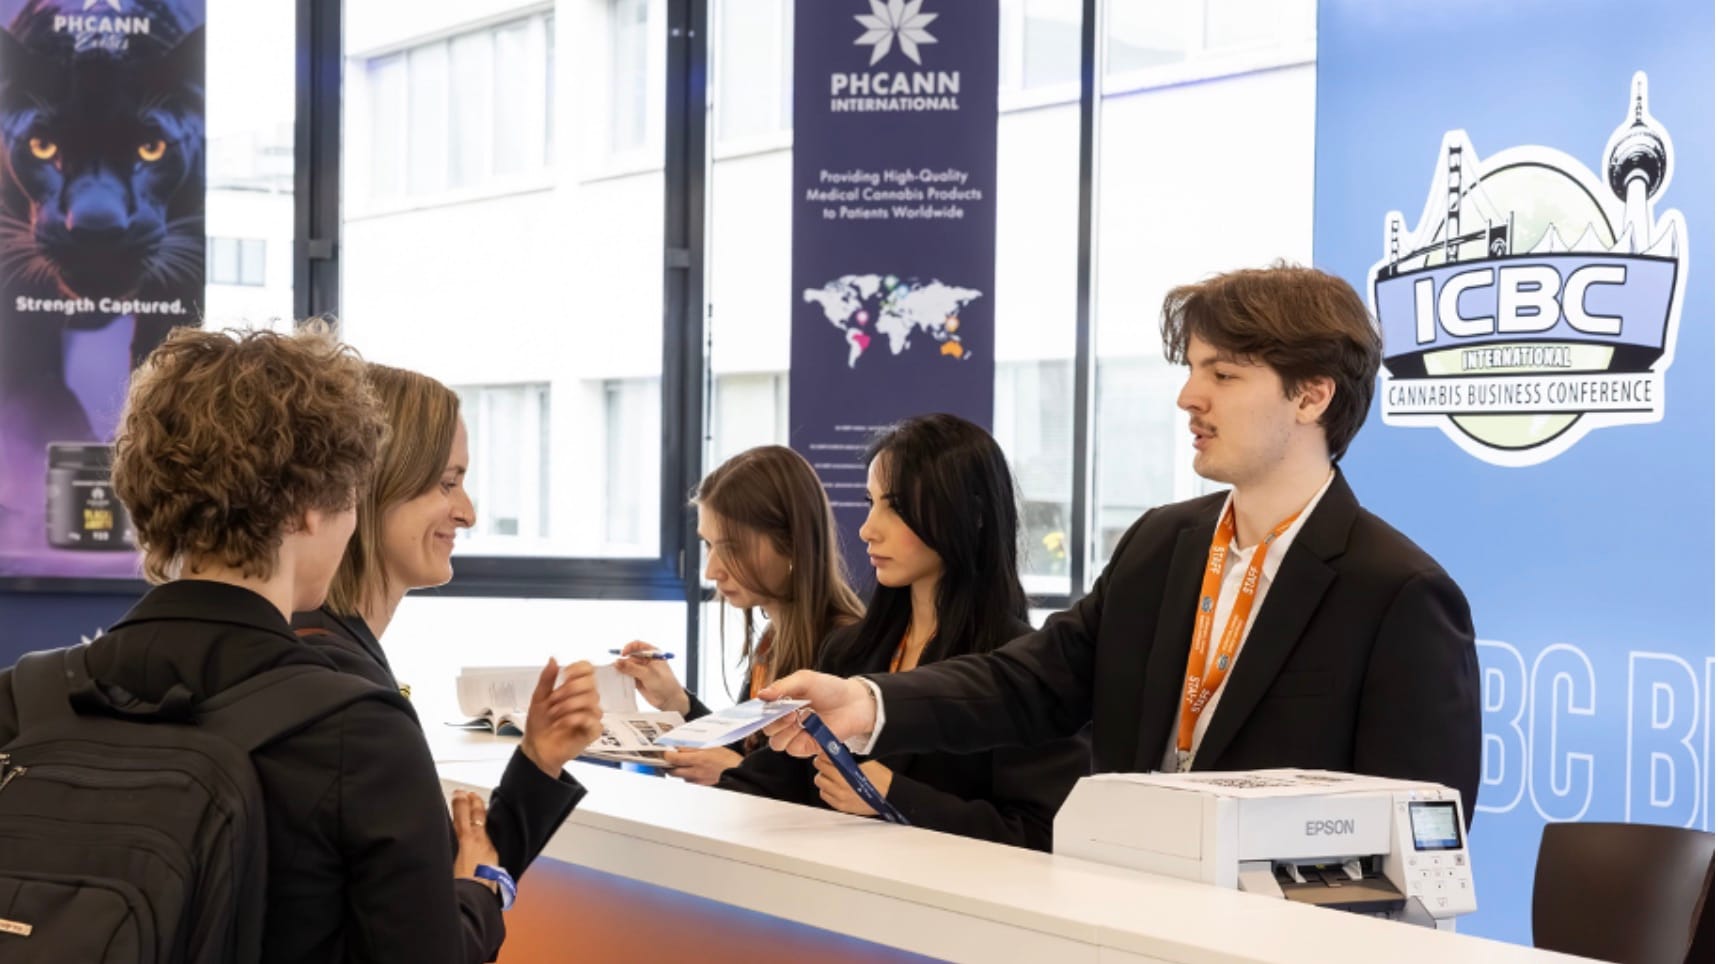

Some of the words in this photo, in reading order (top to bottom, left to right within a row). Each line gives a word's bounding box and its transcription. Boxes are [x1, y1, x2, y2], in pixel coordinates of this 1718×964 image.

[53, 15, 150, 34] PHCANN
[830, 72, 960, 95] PHCANN
[830, 97, 960, 112] INTERNATIONAL
[819, 170, 880, 185] Providing
[883, 168, 968, 185] High-Quality
[806, 189, 859, 201] Medical
[862, 188, 924, 201] Cannabis
[927, 188, 982, 201] Products
[823, 207, 836, 219] to
[839, 206, 889, 219] Patients
[892, 206, 964, 219] Worldwide
[16, 296, 95, 314] Strength
[99, 297, 187, 315] Captured.
[1413, 264, 1628, 345] ICBC
[1461, 347, 1572, 371] INTERNATIONAL
[1388, 384, 1462, 406] CANNABIS
[1468, 382, 1541, 406] BUSINESS
[1547, 380, 1653, 404] CONFERENCE
[1210, 545, 1225, 574] STAFF
[1243, 566, 1258, 594] STAFF
[1305, 819, 1354, 836] EPSON
